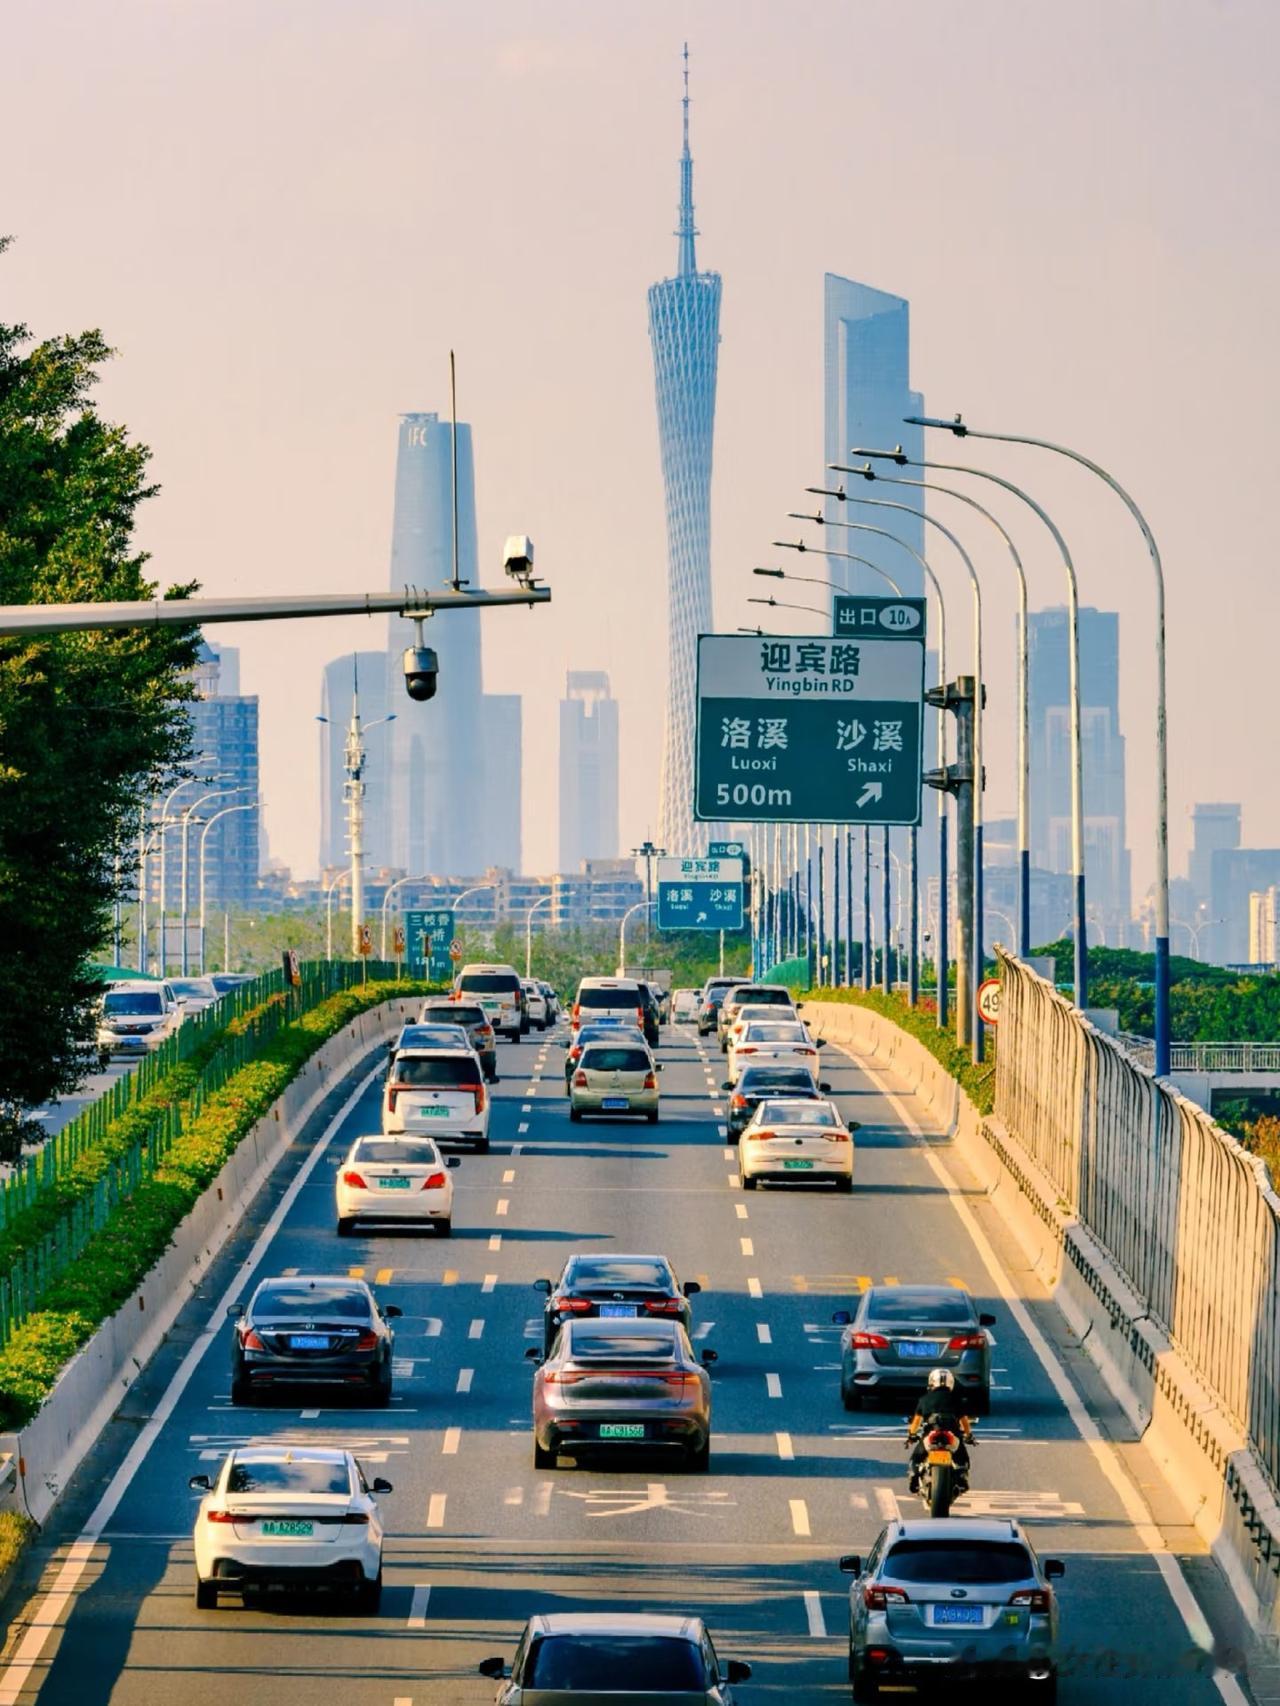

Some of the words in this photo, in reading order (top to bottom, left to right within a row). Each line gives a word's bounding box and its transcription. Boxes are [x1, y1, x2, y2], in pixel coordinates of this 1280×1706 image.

[840, 608, 876, 625] 出口
[889, 609, 911, 625] 10A
[761, 642, 860, 676] 迎宾路
[766, 677, 828, 695] Yingbin
[832, 679, 854, 692] RD
[720, 717, 789, 750] 洛溪
[835, 719, 904, 751] 沙溪
[731, 756, 777, 770] Luoxi
[848, 758, 892, 773] Shaxi
[717, 783, 792, 806] 500m
